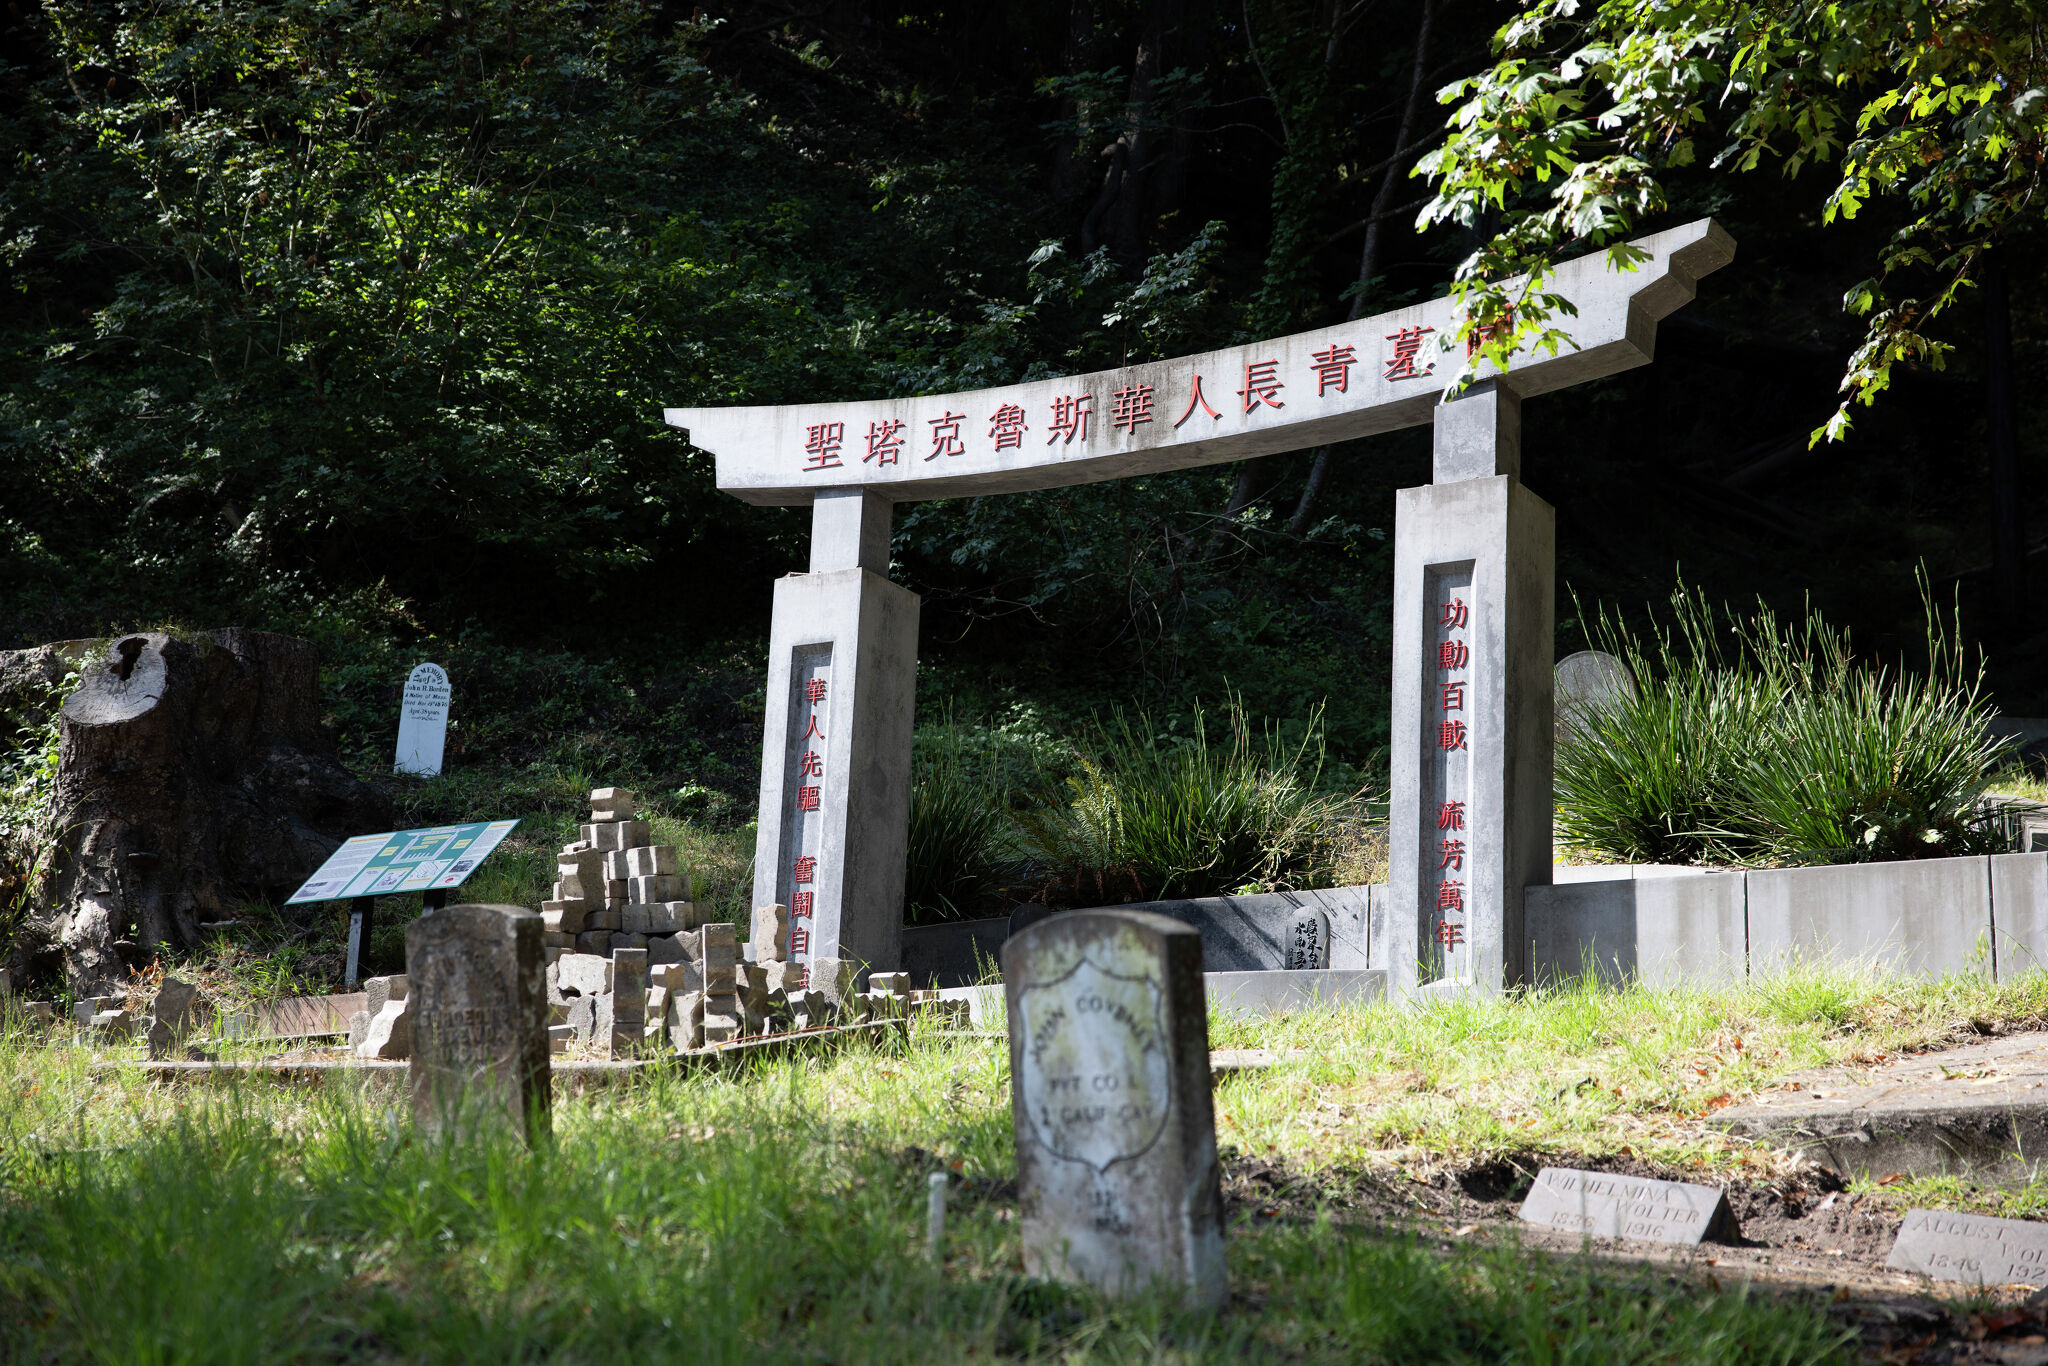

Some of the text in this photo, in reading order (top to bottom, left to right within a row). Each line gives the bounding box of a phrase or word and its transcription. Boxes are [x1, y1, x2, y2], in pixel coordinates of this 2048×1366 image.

[1091, 1073, 1118, 1092] CO
[1546, 1172, 1671, 1204] WILHELMINA
[1614, 1199, 1701, 1225] WOLTER
[1625, 1221, 1666, 1238] 1916
[1911, 1214, 2008, 1241] AUGUST
